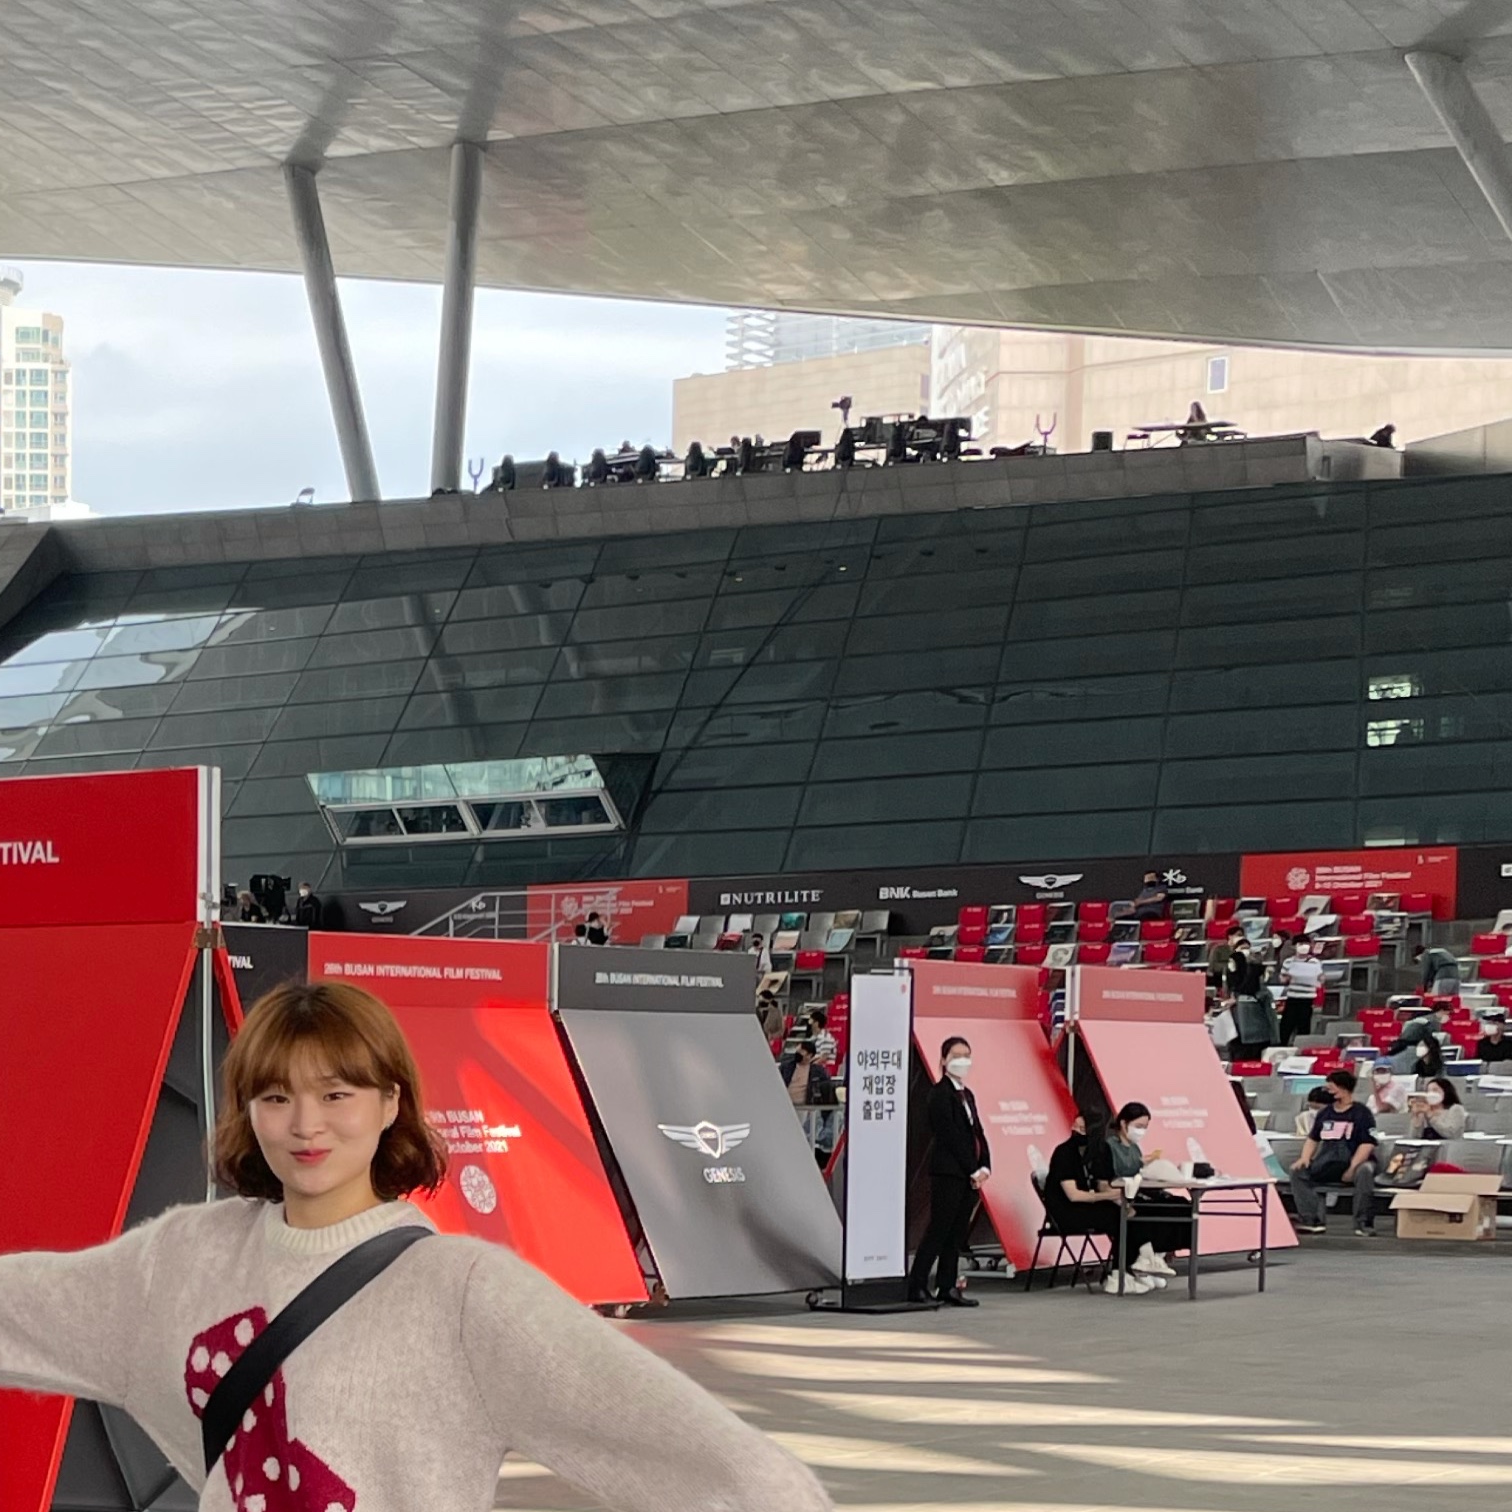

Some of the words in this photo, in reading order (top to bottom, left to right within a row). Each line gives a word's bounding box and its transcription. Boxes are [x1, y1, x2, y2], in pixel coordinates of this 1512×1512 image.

[732, 889, 822, 905] NUTRILITE
[879, 887, 911, 899] BNK
[344, 963, 374, 976] BUSAN
[376, 965, 442, 979] INTERNATIONAL
[444, 967, 464, 979] FILM
[465, 967, 503, 981] FESTIVAL
[857, 1050, 902, 1070] 야외무대
[863, 1075, 896, 1095] 재입장
[446, 1110, 485, 1123] BUSAN
[863, 1100, 895, 1120] 출입구
[703, 1167, 746, 1183] GENESIS
